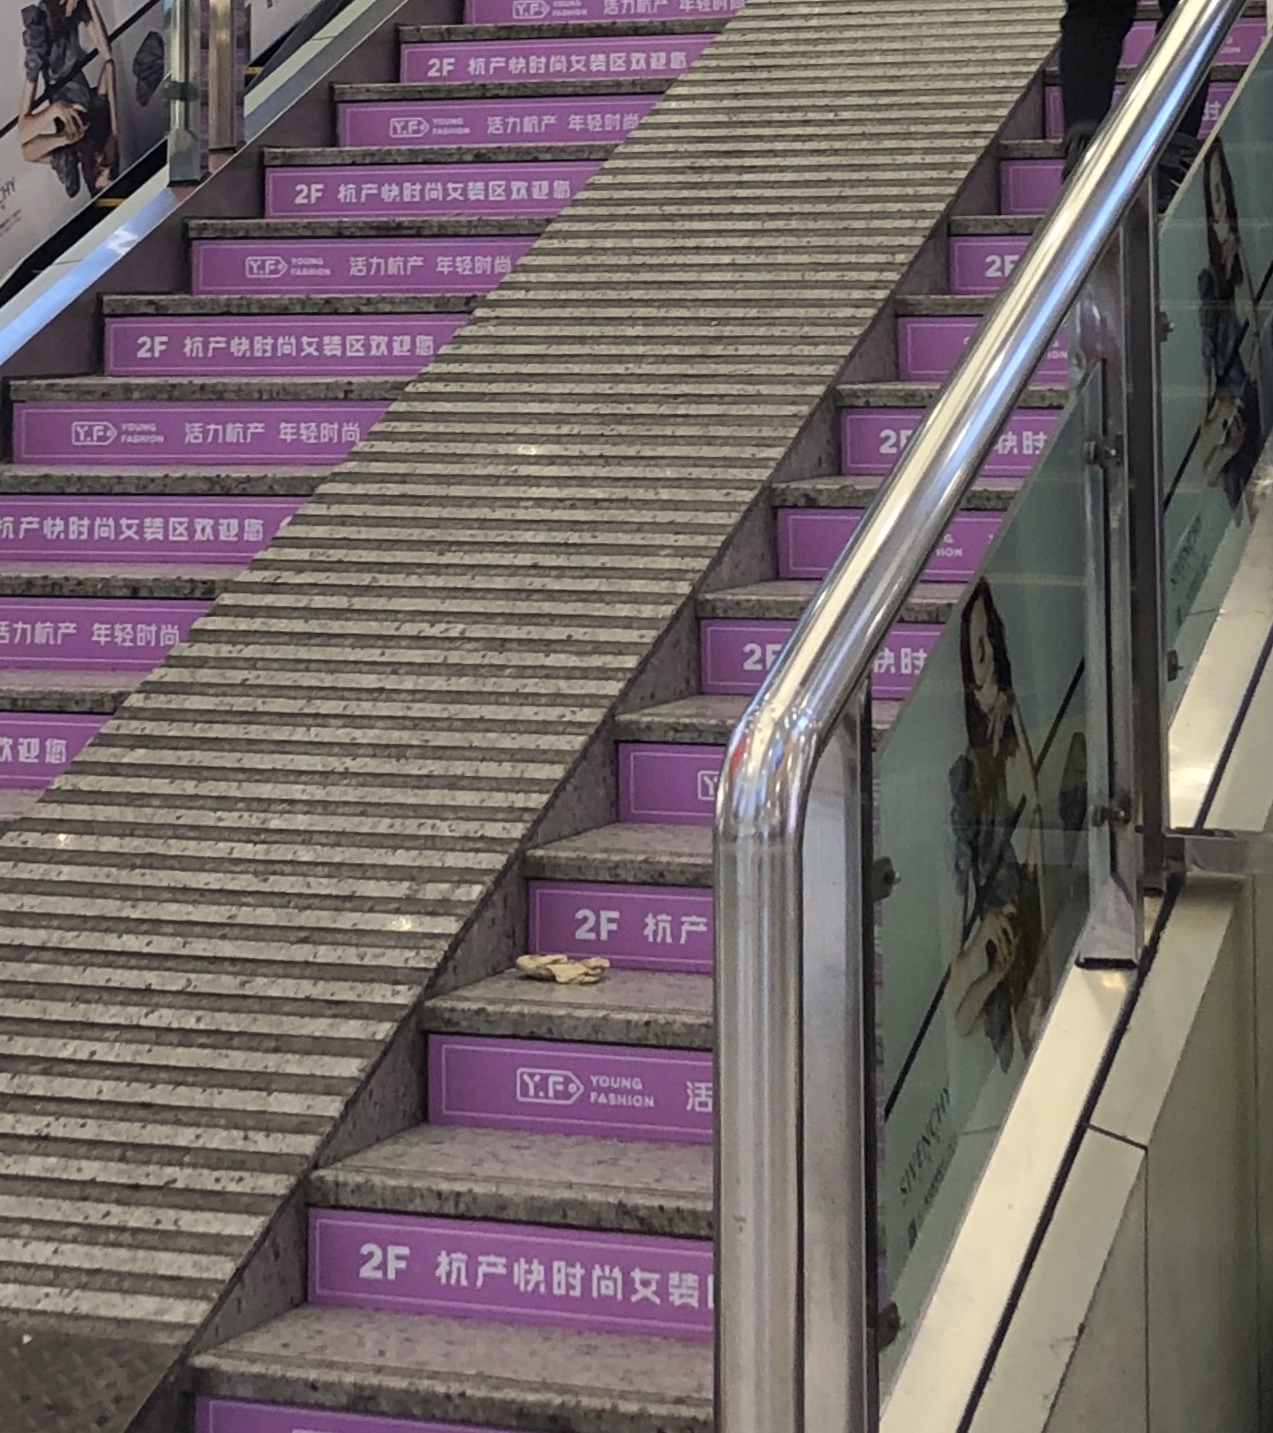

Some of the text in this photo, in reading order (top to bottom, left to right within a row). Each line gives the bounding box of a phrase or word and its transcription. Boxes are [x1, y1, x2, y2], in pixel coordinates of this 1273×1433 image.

[428, 58, 455, 77] 2F
[487, 113, 640, 135] 活力杭产 年轻时尚
[295, 185, 324, 204] 2F
[349, 255, 511, 277] 活力杭产 年轻时尚
[137, 336, 434, 358] 2F 杭产快时尚女装区欢迎您
[185, 422, 361, 444] 活力杭产 年轻时尚
[91, 622, 180, 647] 年轻时尚
[575, 909, 708, 945] 2F 杭产
[590, 1076, 643, 1090] YOUNG
[590, 1092, 654, 1107] FASHION
[359, 1244, 714, 1309] 2F 杭产快时尚女装
